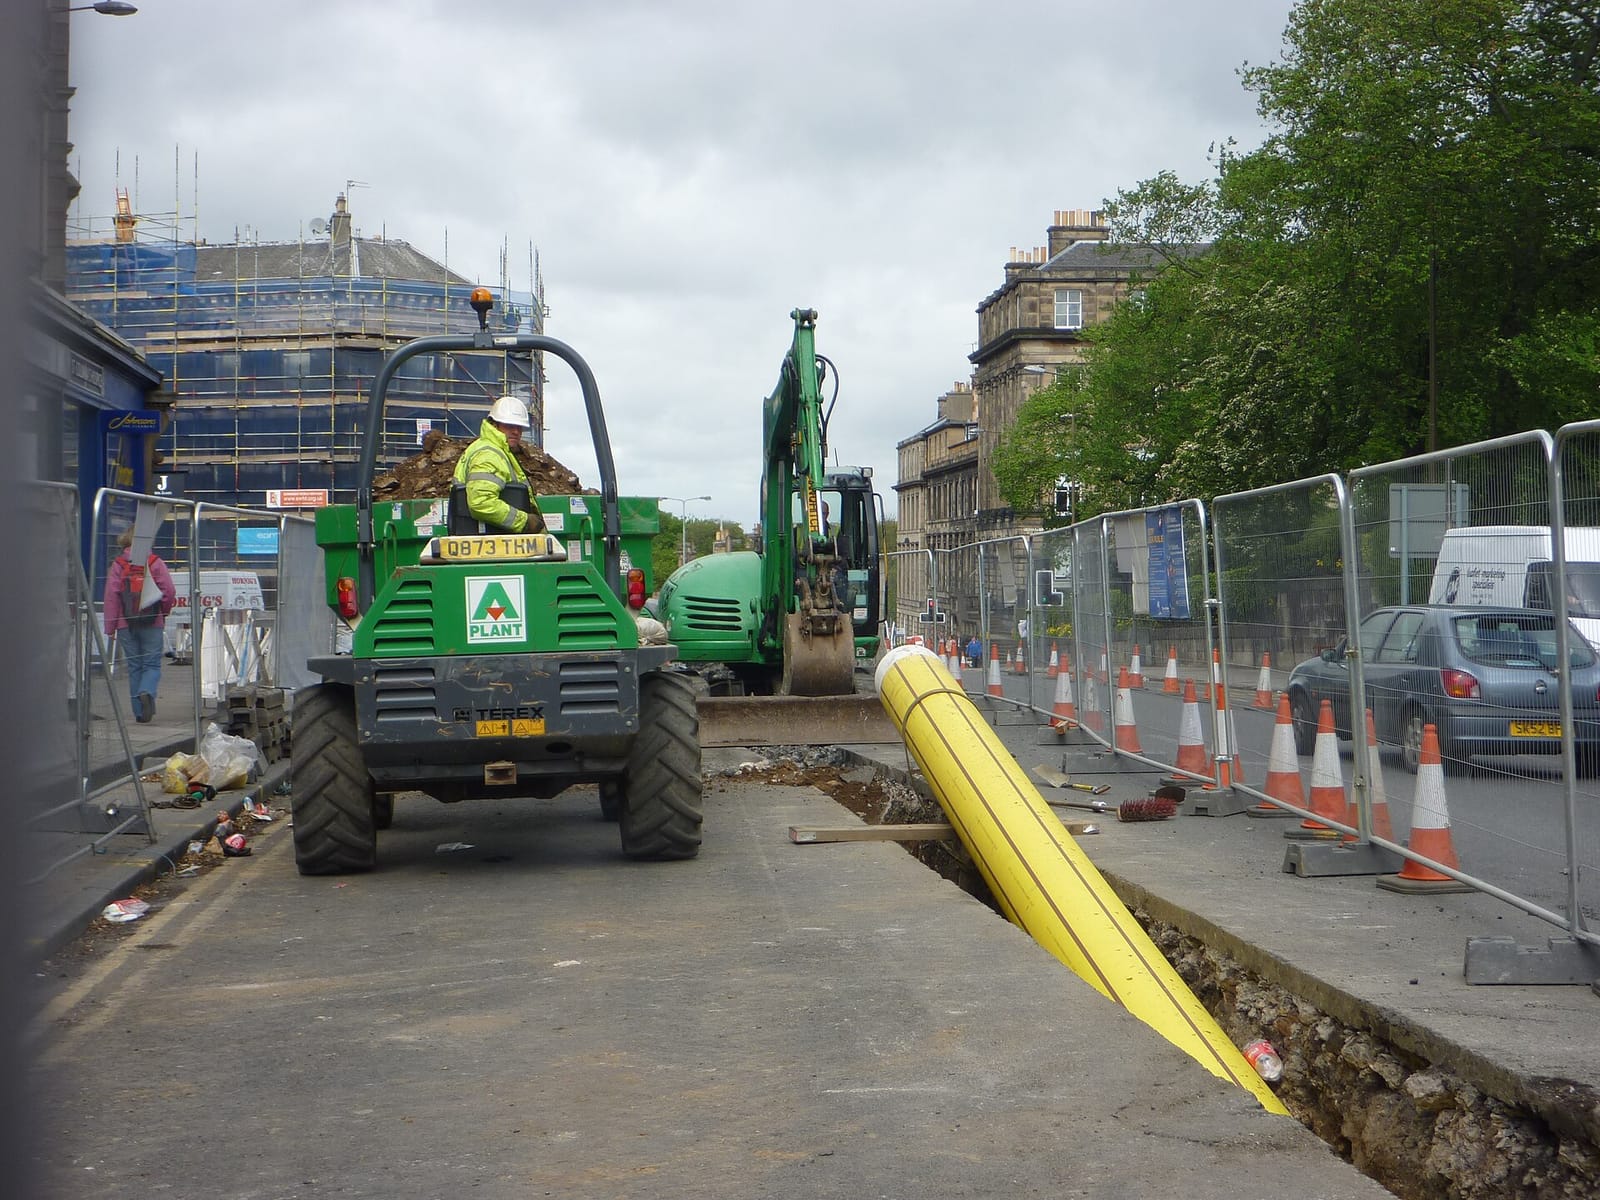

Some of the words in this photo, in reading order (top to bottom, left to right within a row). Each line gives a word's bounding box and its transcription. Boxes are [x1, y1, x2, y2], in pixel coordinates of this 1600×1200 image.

[448, 540, 496, 556] Q873
[502, 537, 537, 554] THM
[472, 582, 520, 620] A
[470, 623, 523, 637] PLANT
[476, 706, 544, 720] TEREX
